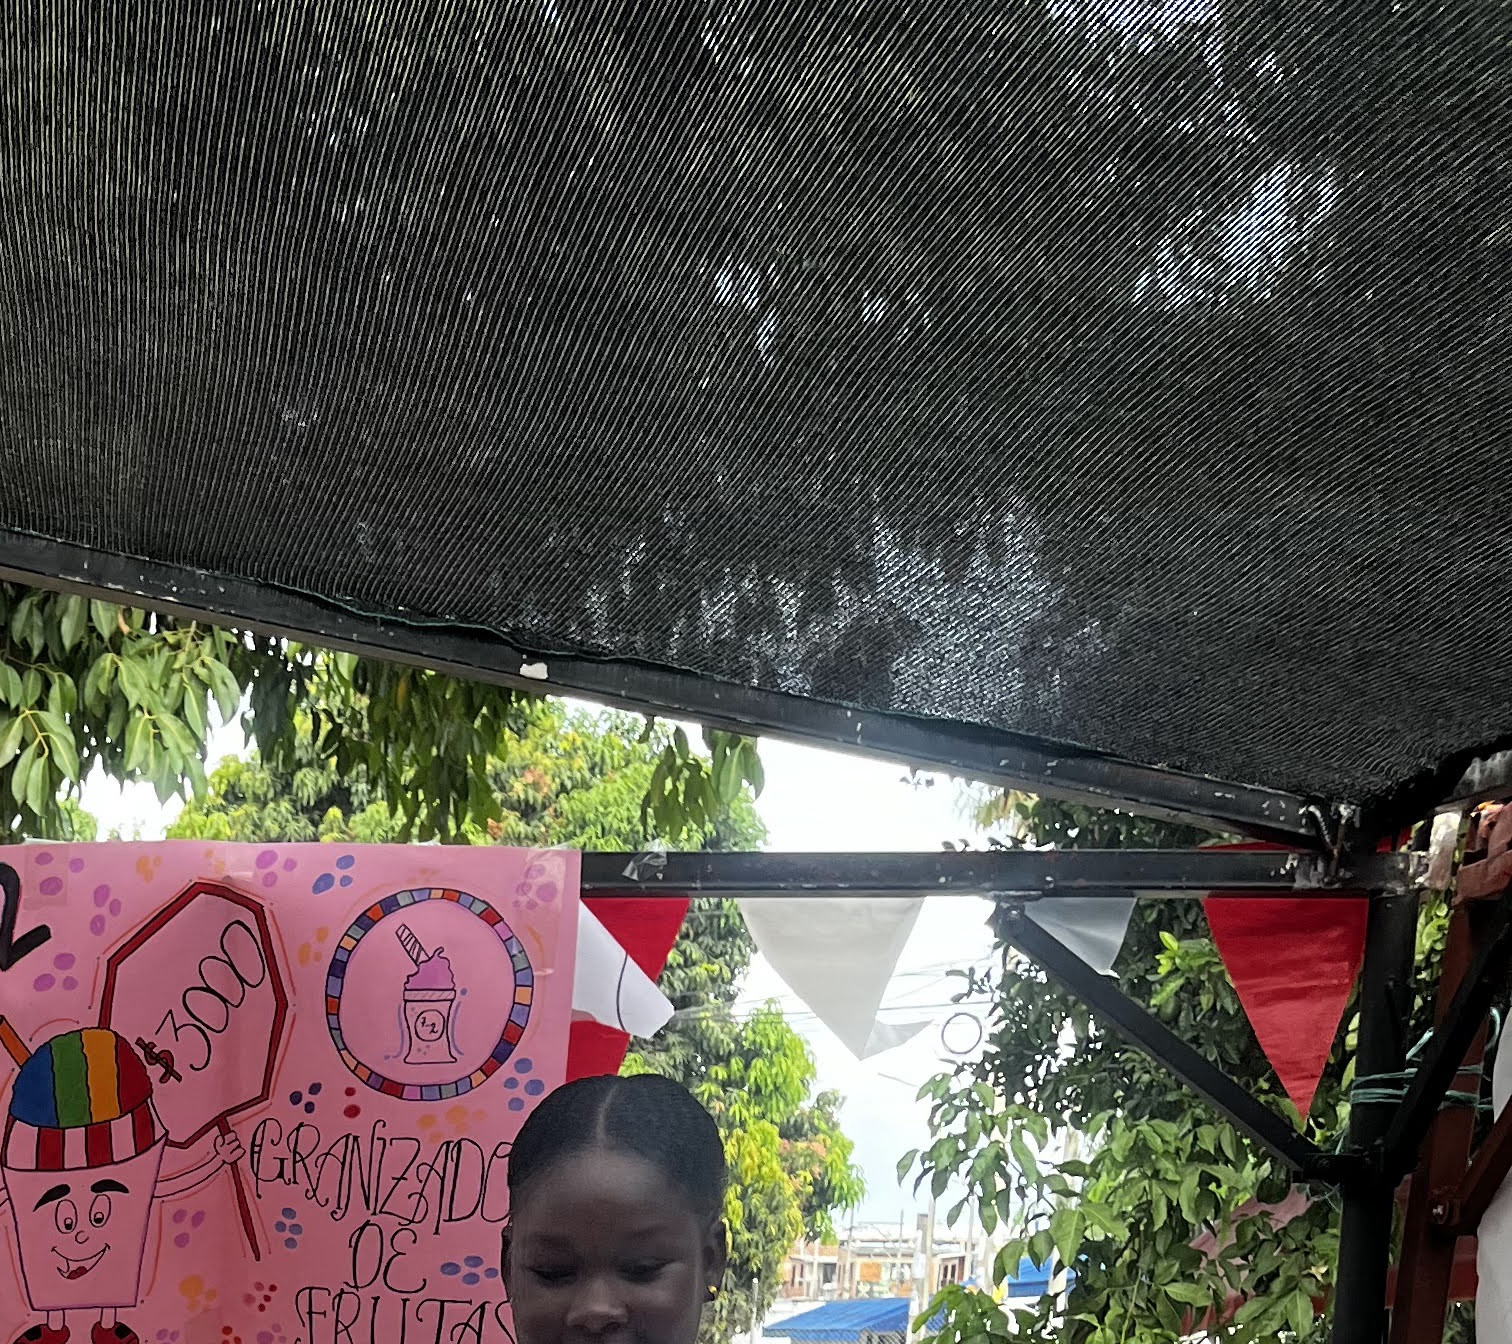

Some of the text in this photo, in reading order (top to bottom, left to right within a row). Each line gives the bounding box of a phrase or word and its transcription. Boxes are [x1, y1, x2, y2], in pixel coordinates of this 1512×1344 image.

[134, 919, 267, 1084] $3000
[421, 1016, 438, 1034] 7-2
[349, 1222, 427, 1294] DE
